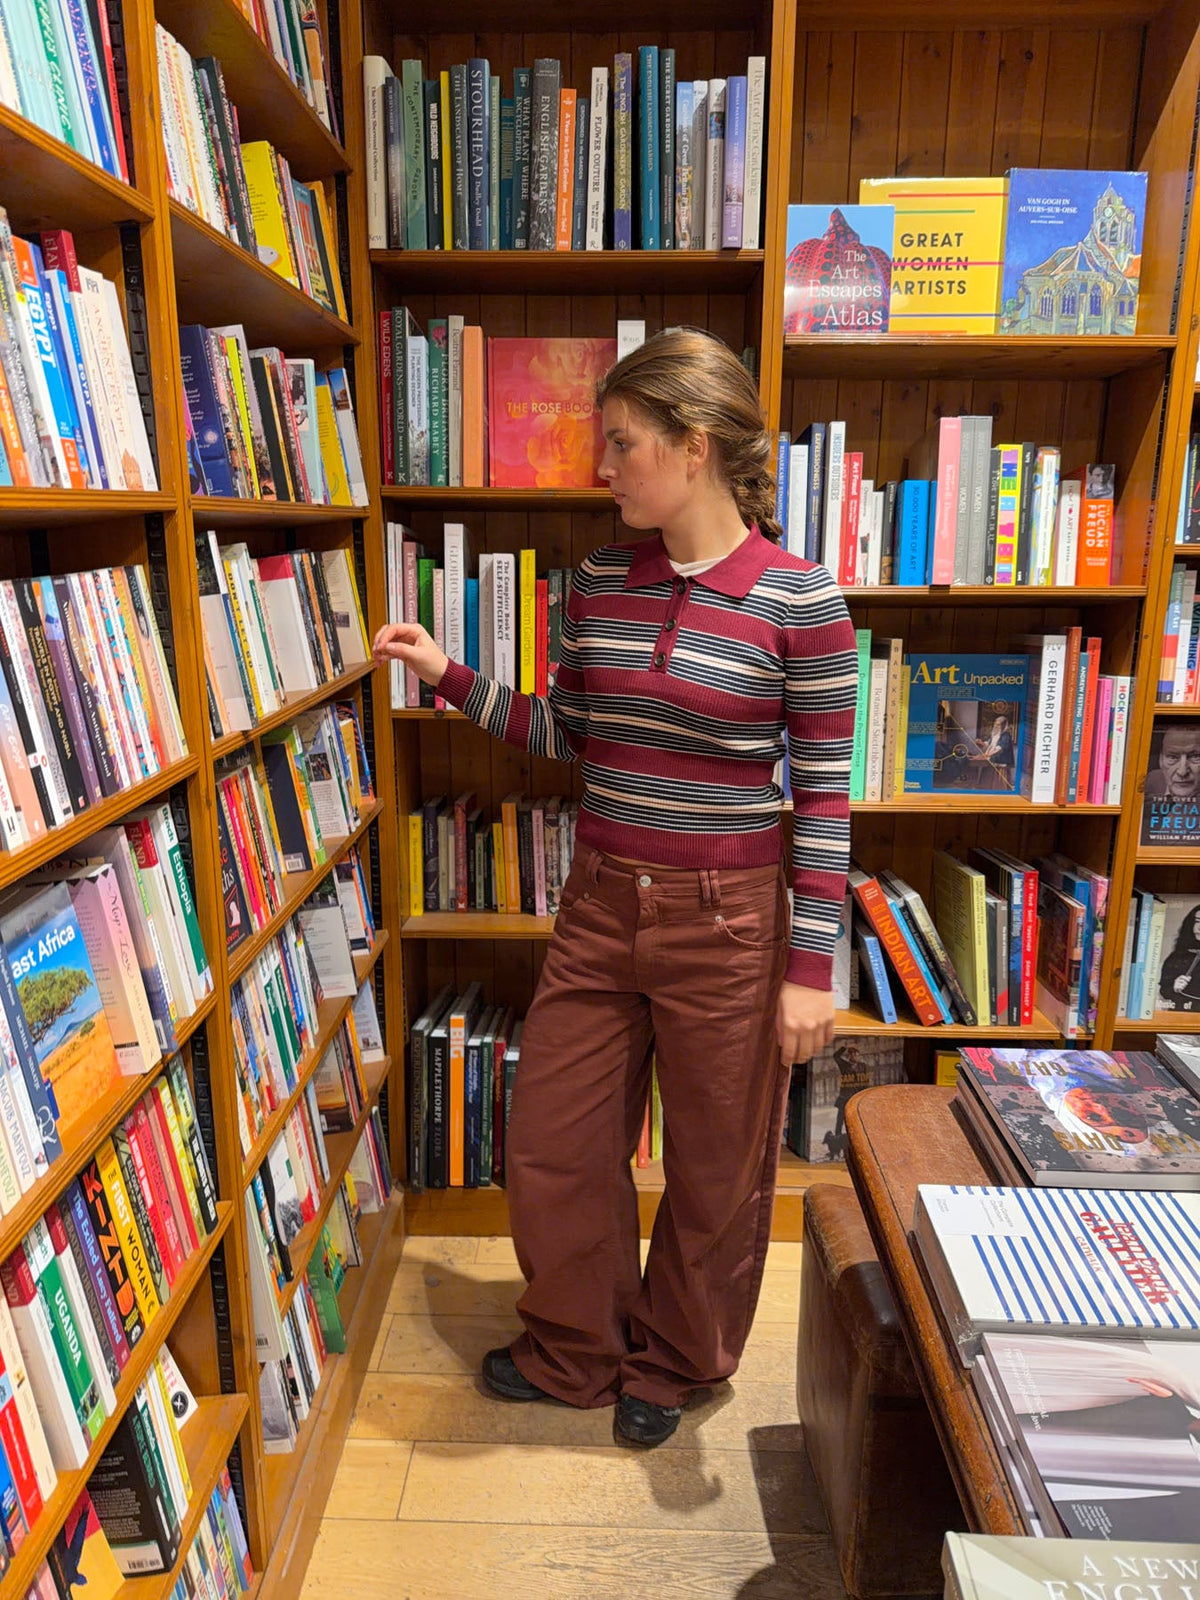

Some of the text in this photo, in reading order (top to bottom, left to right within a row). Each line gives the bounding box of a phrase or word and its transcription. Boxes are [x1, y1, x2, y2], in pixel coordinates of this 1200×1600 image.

[429, 103, 438, 160] WILD NEIGHBOURS
[470, 70, 484, 227] STOURHEAD Dudley Dodd
[521, 97, 530, 200] WHAT PLANT WHERE
[594, 116, 602, 151] FLOWER
[750, 68, 762, 196] The Art of Fine Gardening
[539, 95, 550, 214] ENGLISH GARDENS
[592, 154, 600, 192] COUTURE
[844, 250, 866, 262] The
[900, 233, 964, 248] GREAT
[69, 250, 79, 286] ELAND
[831, 264, 859, 280] Art
[892, 256, 968, 271] WOMEN
[808, 280, 882, 301] Escapes
[892, 280, 966, 295] ARTISTS
[28, 286, 55, 368] EGYPT
[44, 292, 58, 332] Egypt
[394, 310, 402, 342] ROYAL
[821, 304, 882, 326] Atlas
[382, 318, 391, 344] WILD
[78, 362, 92, 407] EGYPT
[94, 305, 124, 433] ANCIENT EGYPT
[0, 389, 18, 448] NOMADS
[812, 433, 821, 490] EXPRESSIONISTS
[830, 433, 842, 500] INSIDERS OUTSIDERS
[851, 474, 859, 495] Fraud
[958, 486, 967, 513] WOMEN
[974, 486, 982, 513] WOMEN
[910, 514, 919, 540] YEARS
[1086, 504, 1096, 547] FREUD
[1096, 504, 1105, 547] LUCIAN
[910, 542, 917, 553] OF
[449, 546, 460, 660] GLORIOUS GARDENS
[1172, 572, 1185, 604] Colours
[62, 601, 76, 635] Amitav
[228, 573, 254, 669] DON'T LET GO
[523, 594, 533, 626] Dream
[1171, 616, 1180, 629] Art
[72, 637, 84, 672] Ghosh
[524, 627, 533, 666] Gardens
[147, 640, 164, 697] CAIRO
[890, 646, 900, 719] BANKSY
[911, 661, 1023, 686] Art Unpacked
[34, 627, 46, 665] TRAVELS
[45, 678, 58, 705] EGYPT
[53, 707, 63, 727] AND
[59, 729, 72, 758] NUBIA
[85, 694, 92, 707] an
[1116, 686, 1128, 733] HOCKNEY
[88, 712, 104, 750] Antique
[870, 688, 882, 780] Botanical Sketchbooks
[1040, 660, 1058, 774] GERHARD RICHTER
[856, 723, 864, 748] Present
[99, 752, 111, 777] Land
[130, 827, 146, 864] ELAND
[147, 832, 156, 860] ELAND
[162, 807, 192, 915] Bradt Ethiopia
[876, 914, 932, 1010] INDIAN ART
[1150, 942, 1159, 974] Modersohn
[451, 1026, 464, 1059] BIG
[1003, 1060, 1136, 1079] IN GAZA
[0, 1077, 31, 1177] NAGUIB MAHFOUZ
[108, 1169, 116, 1181] THE
[111, 1180, 130, 1227] FIRST
[34, 1224, 49, 1258] Bradt
[1075, 1236, 1103, 1272] CATWALK
[1080, 1211, 1169, 1304] GAULTIER
[22, 1260, 34, 1293] ELAND
[72, 1189, 122, 1344] The Exiled Lucy Fulford
[127, 1228, 150, 1298] WOMAN
[55, 1289, 81, 1368] UGANDA
[1082, 1555, 1200, 1580] A NEW
